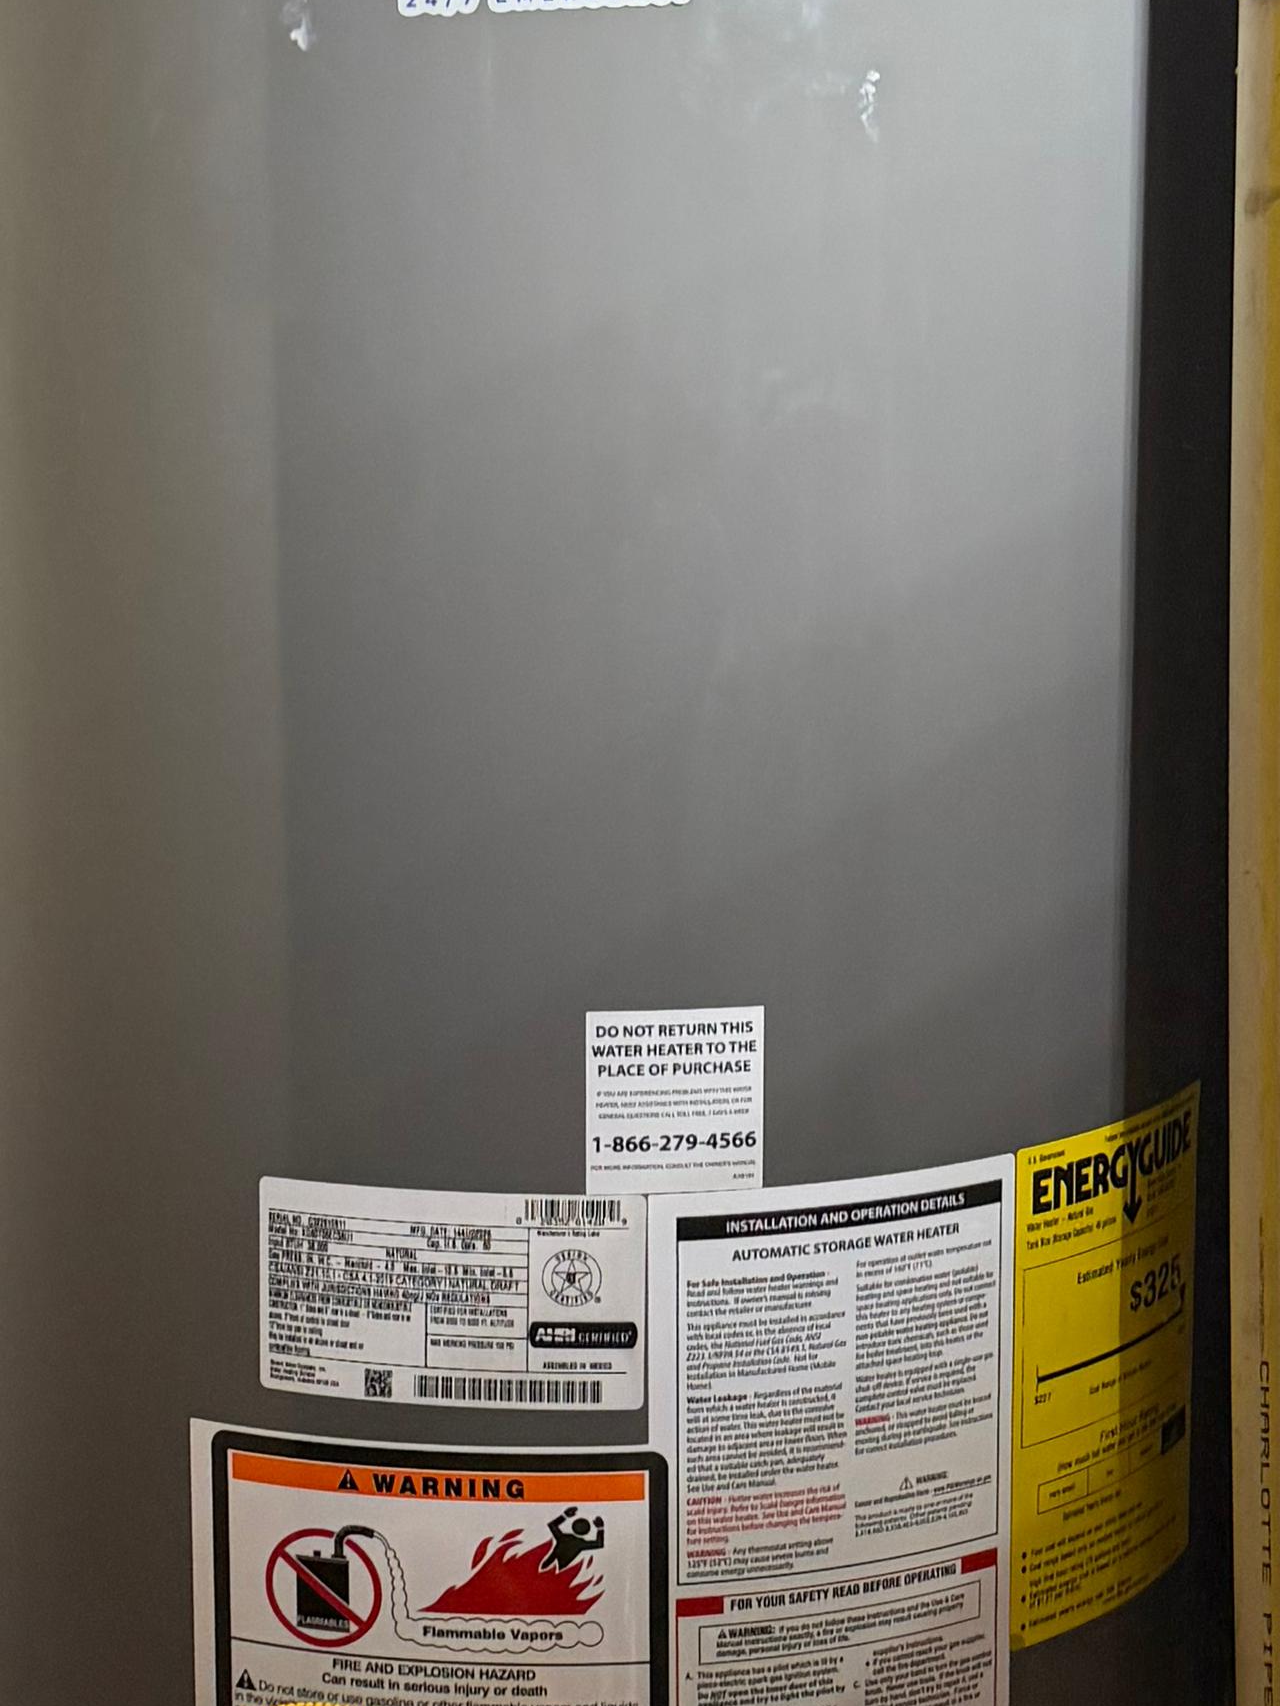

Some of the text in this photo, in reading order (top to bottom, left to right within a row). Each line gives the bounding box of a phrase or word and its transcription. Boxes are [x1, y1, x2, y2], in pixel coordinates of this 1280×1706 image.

[596, 1020, 754, 1038] DO NOT RETURN THIS
[592, 1040, 757, 1058] WATER HEATER TO THE
[598, 1059, 751, 1077] PLACE OF PURCHASE
[592, 1130, 757, 1153] 1-866-279-4566
[1032, 1110, 1192, 1216] ENERGYGUIDE
[725, 1192, 966, 1234] INSTALLATION AND OPERATION DETAILS
[732, 1223, 960, 1262] AUTOMATIC STORAGE WATER HEATER
[385, 1248, 418, 1261] NATURAL
[1076, 1253, 1137, 1285] Estimated Yearly
[395, 1276, 443, 1289] CATEGORY
[491, 1280, 519, 1292] DRAFT
[686, 1270, 825, 1289] For Safe Installation and Operation
[1129, 1252, 1182, 1313] $325
[535, 1327, 629, 1343] AHRI CERTIFIED
[542, 1362, 612, 1370] ASSEMBLED IN MEXICO
[686, 1393, 748, 1405] Water Leakage
[1258, 1359, 1273, 1587] CHARLOTTE
[372, 1471, 526, 1501] WARNING
[686, 1496, 722, 1507] CAUTION
[730, 1563, 957, 1612] FOR YOUR SAFETY READ BEFORE OPERATING
[422, 1625, 564, 1643] Flammable Vapors
[728, 1625, 776, 1639] WARNING:
[332, 1657, 536, 1681] FIRE AND EXPLOSION HAZARD
[258, 1680, 275, 1692] Do
[277, 1683, 295, 1696] not
[296, 1685, 325, 1701] store
[326, 1689, 339, 1701] or
[341, 1692, 363, 1704] use
[321, 1672, 347, 1685] Can
[350, 1675, 385, 1690] result
[388, 1678, 400, 1690] in
[403, 1678, 450, 1694] serious
[493, 1686, 507, 1696] or
[511, 1685, 548, 1697] death
[234, 1692, 264, 1705] in the
